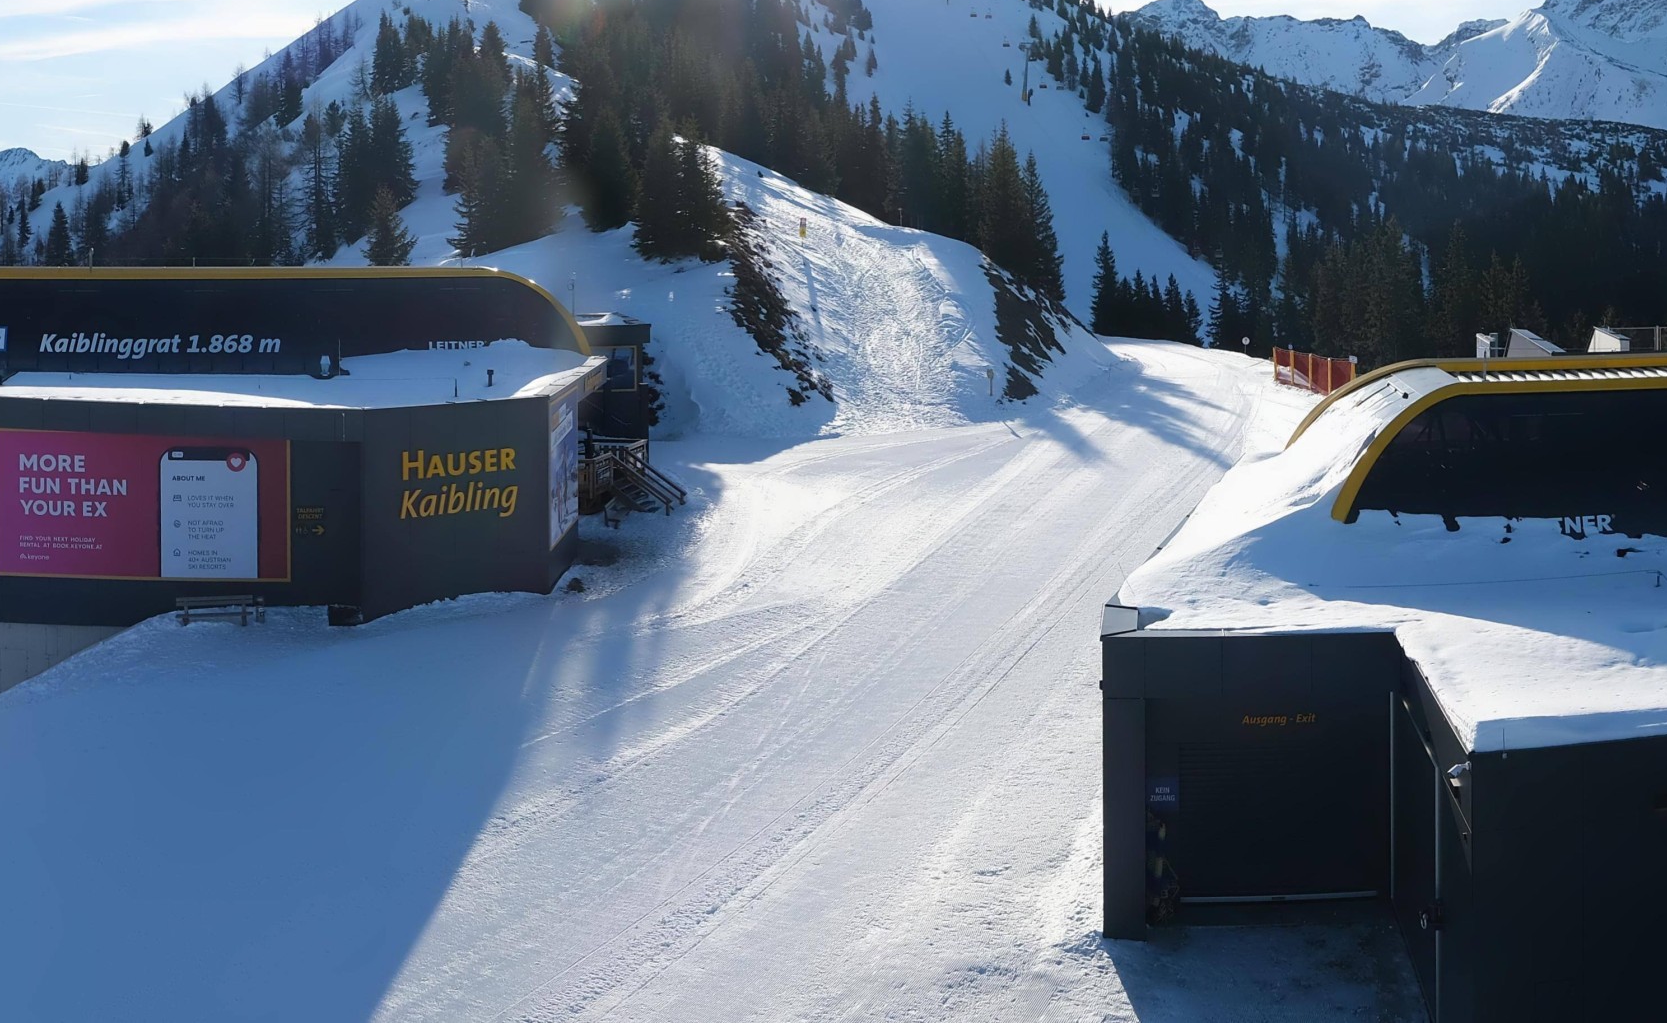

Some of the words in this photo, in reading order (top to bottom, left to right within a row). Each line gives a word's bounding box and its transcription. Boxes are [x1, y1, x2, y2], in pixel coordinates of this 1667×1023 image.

[39, 333, 181, 359] Kaiblinggrat
[186, 334, 253, 353] 1.868
[259, 338, 281, 353] m
[19, 454, 86, 472] MORE
[402, 448, 516, 480] HAUSER
[19, 477, 60, 494] FUN
[68, 478, 127, 496] THAN
[20, 500, 76, 516] YOUR
[82, 501, 108, 517] EX
[400, 481, 518, 520] Kaibling
[1241, 715, 1287, 727] Ausgang
[1295, 712, 1316, 723] Exit
[1150, 794, 1176, 802] ZUGANG
[1155, 786, 1170, 794] KEIN
